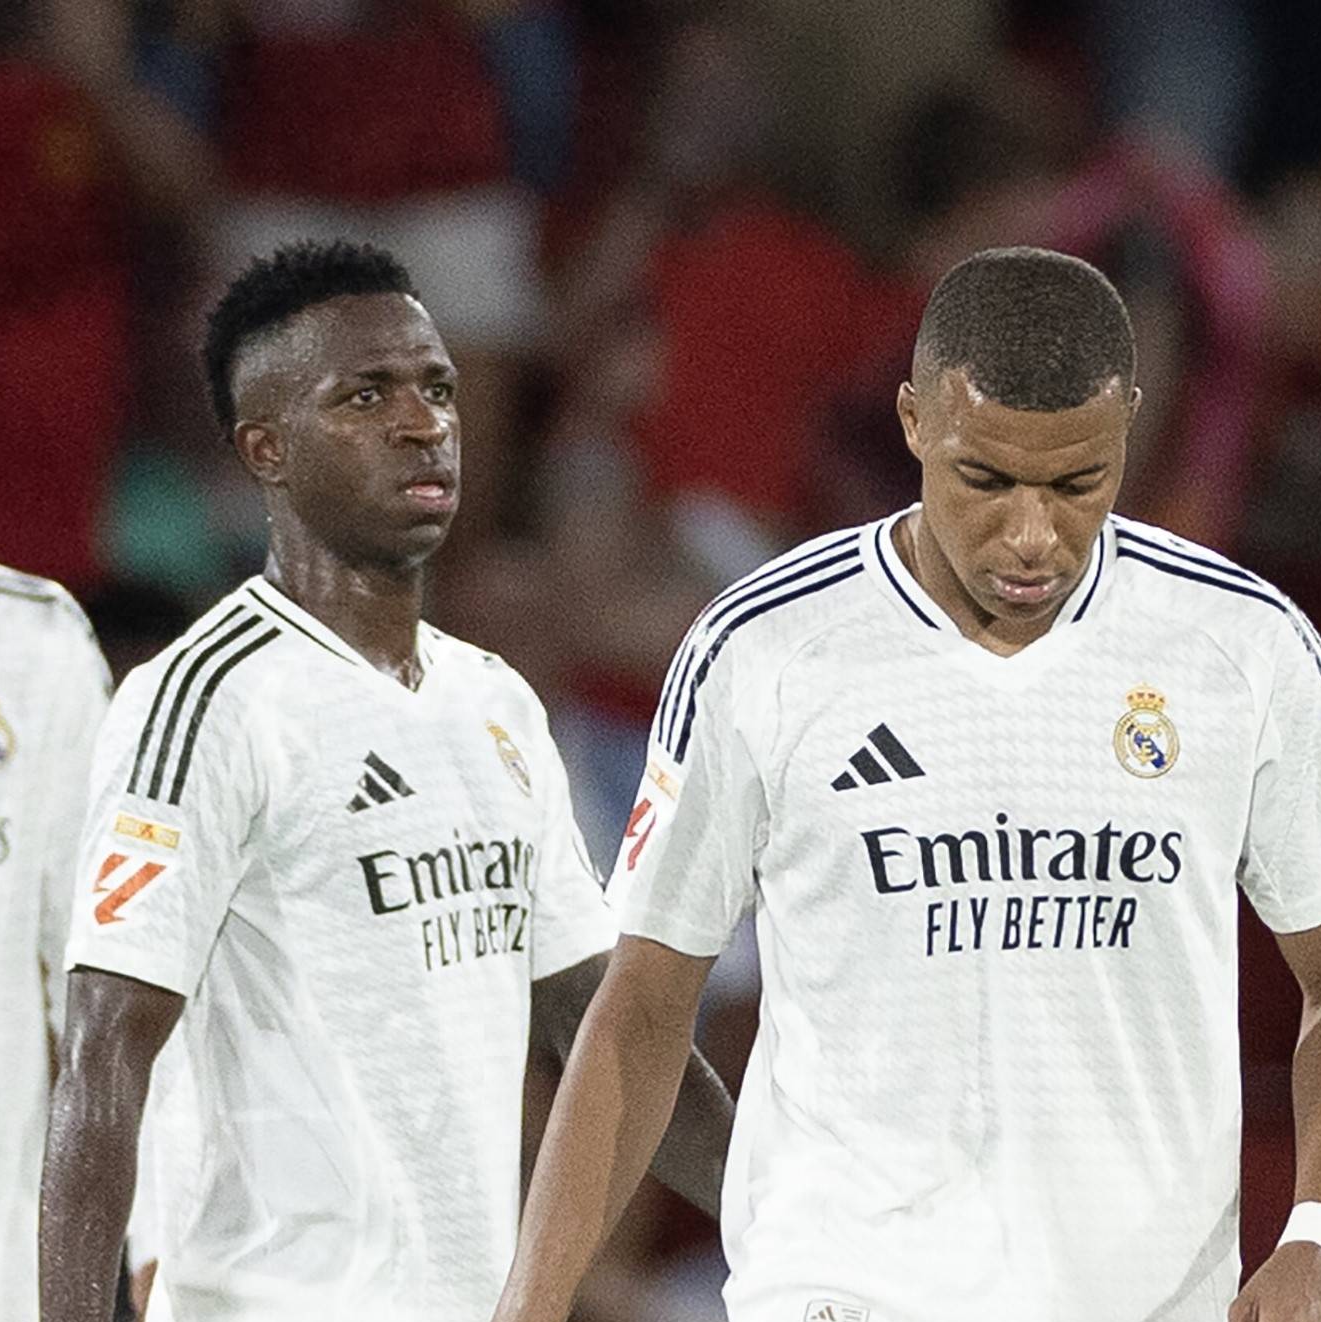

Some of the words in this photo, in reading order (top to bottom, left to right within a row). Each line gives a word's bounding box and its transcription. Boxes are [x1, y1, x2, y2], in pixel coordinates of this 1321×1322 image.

[860, 812, 1182, 894] Emirates
[422, 909, 461, 971] FLY
[926, 897, 989, 956] FLY
[1001, 895, 1138, 951] BETTER
